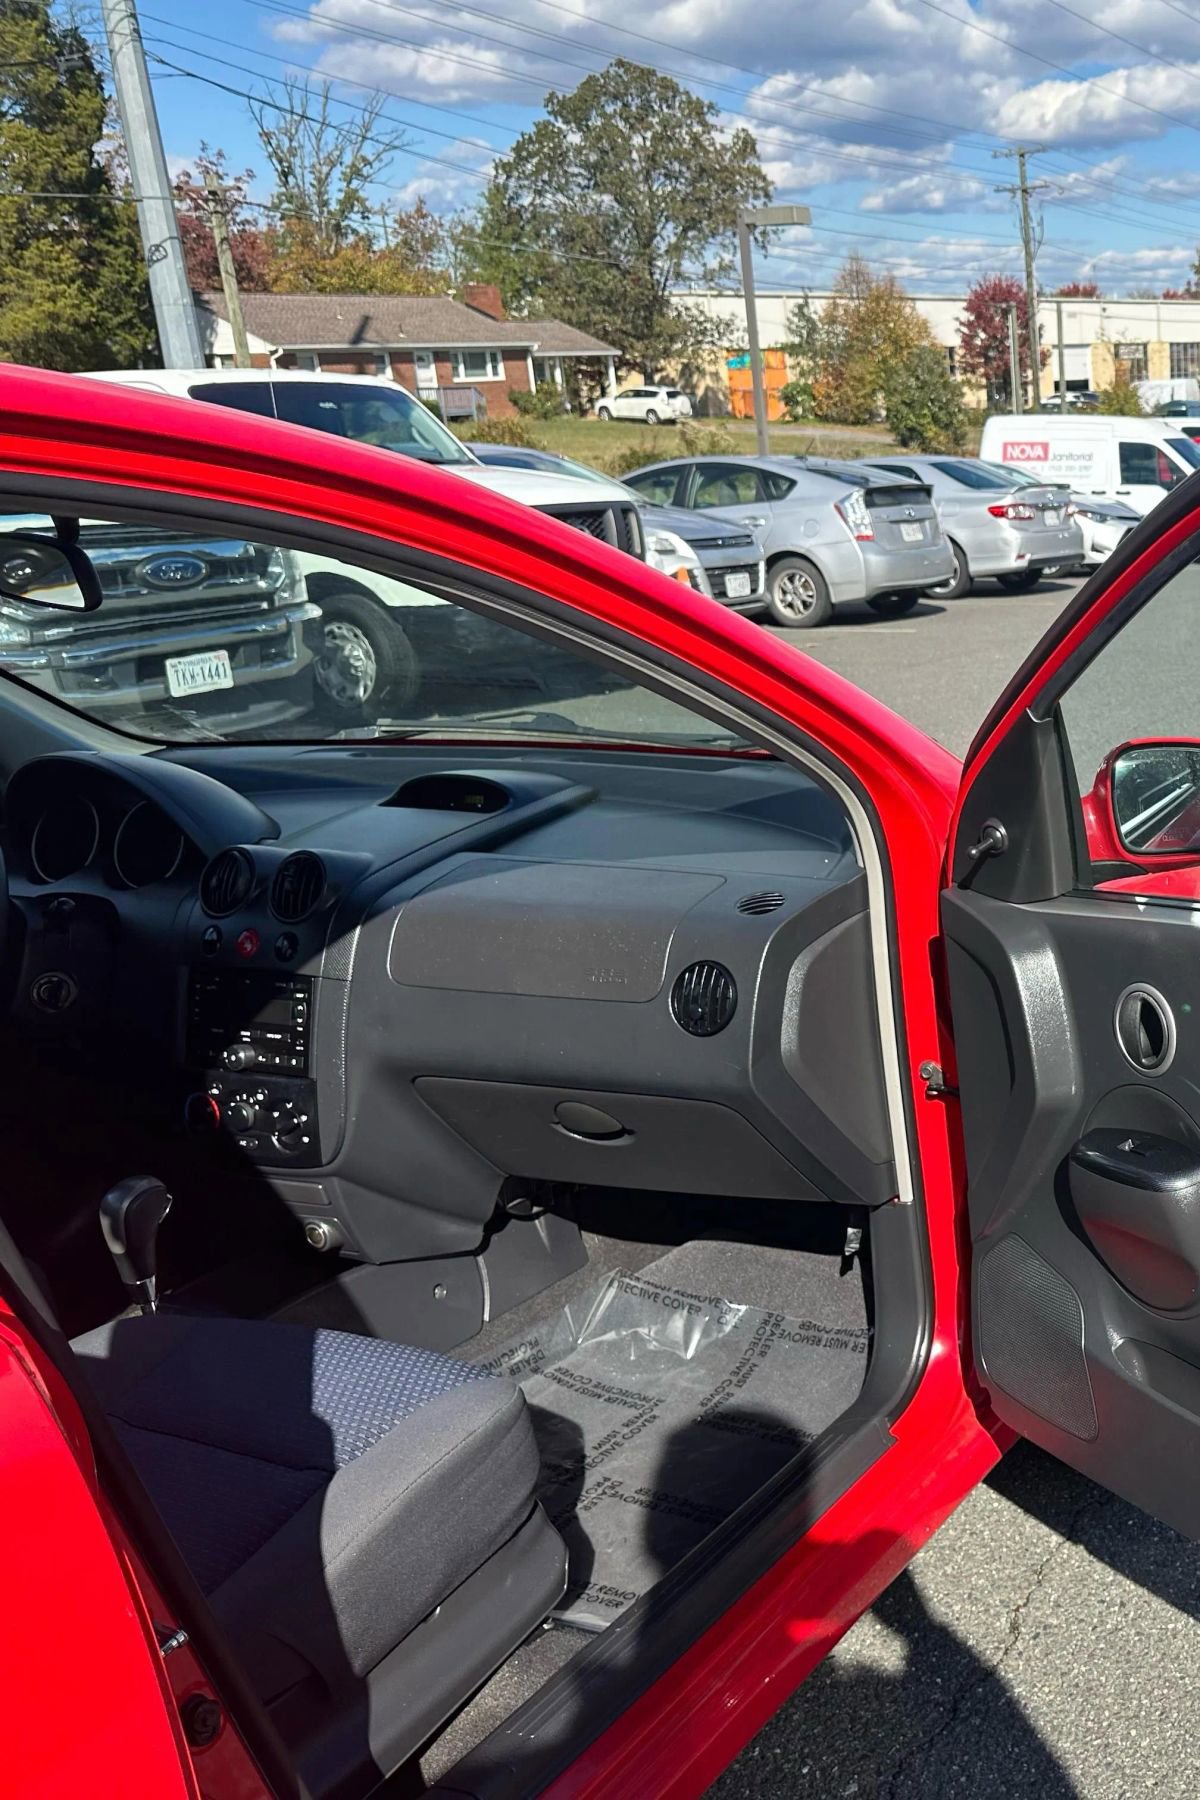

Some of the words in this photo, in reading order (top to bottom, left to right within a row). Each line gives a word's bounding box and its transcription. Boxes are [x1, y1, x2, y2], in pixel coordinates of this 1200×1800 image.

[1006, 444, 1044, 459] NOVA
[1050, 452, 1093, 462] Janitorial
[160, 562, 194, 580] Ford
[662, 1295, 702, 1316] COVER
[730, 1311, 774, 1377] PROTECTIVE
[757, 1312, 785, 1358] DEALER
[778, 1328, 822, 1347] REMOVE
[824, 1336, 848, 1350] MUST
[510, 1349, 545, 1377] DEALER
[555, 1366, 593, 1385] COVER
[733, 1361, 759, 1388] MUST
[578, 1387, 602, 1400] MUST
[700, 1378, 733, 1407] COVER
[603, 1396, 646, 1412] DEALER
[622, 1414, 660, 1440] COVER
[592, 1429, 621, 1452] MUST
